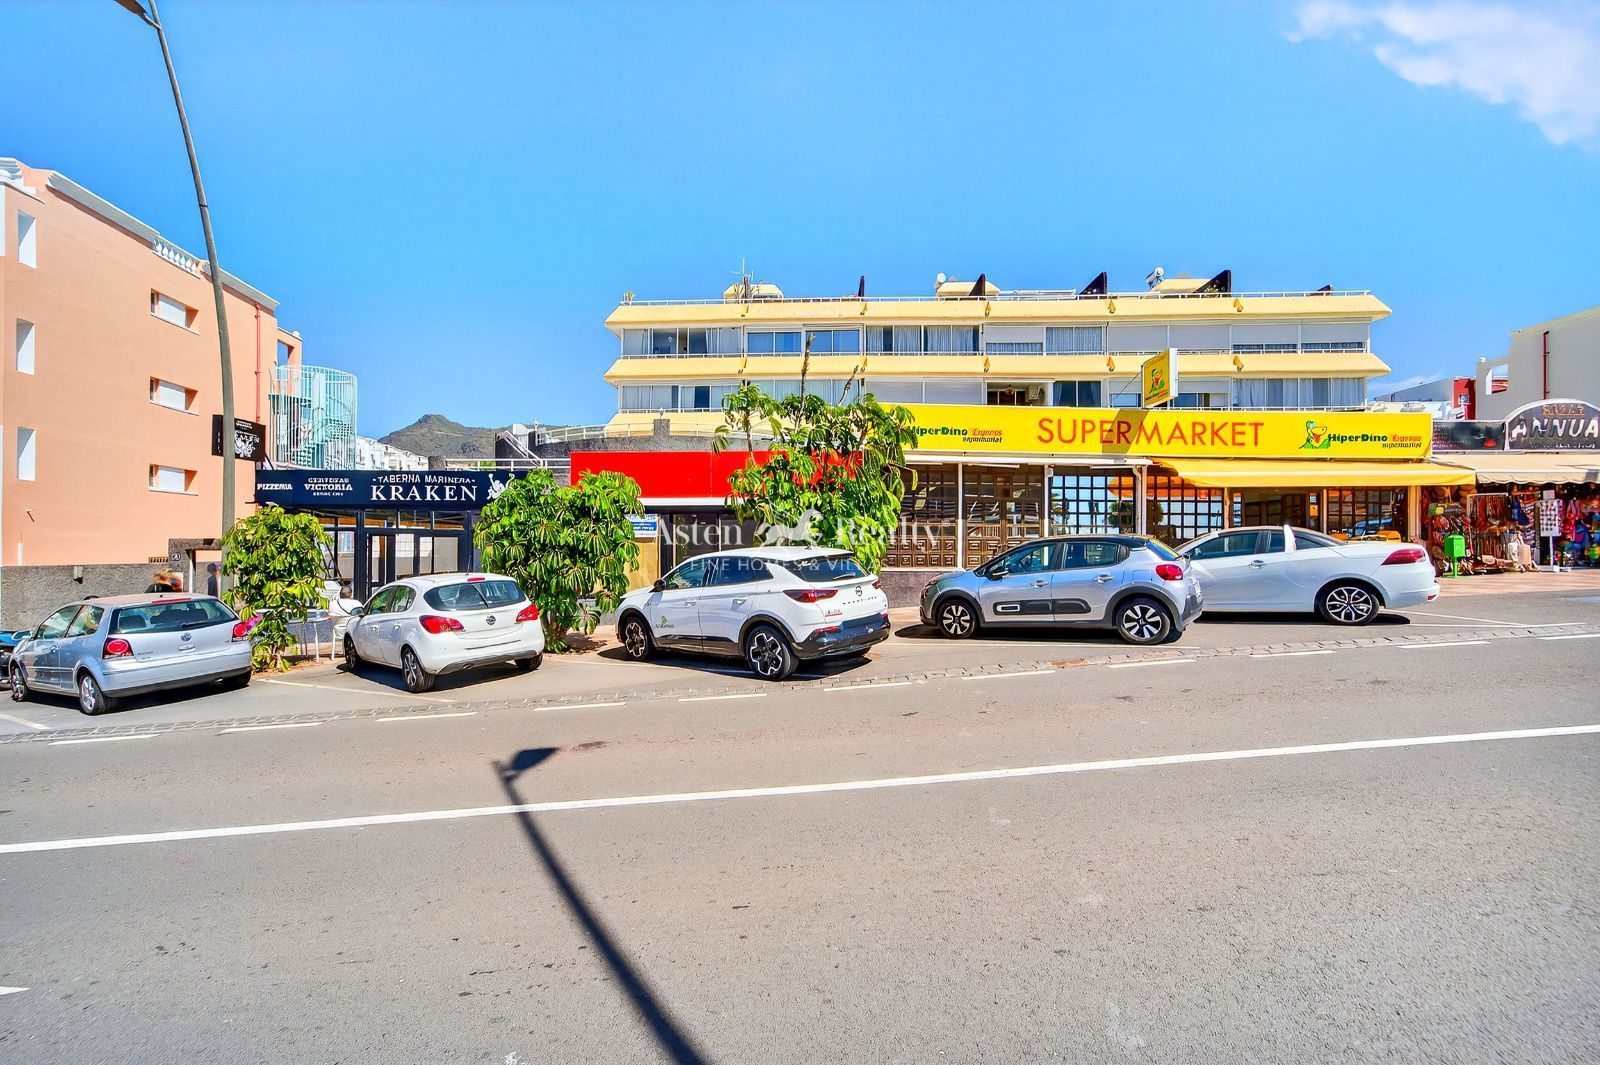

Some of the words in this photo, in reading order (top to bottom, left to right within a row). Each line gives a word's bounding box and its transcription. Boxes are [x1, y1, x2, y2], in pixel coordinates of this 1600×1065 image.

[1327, 433, 1388, 443] HiperDino
[256, 483, 293, 491] PIZZERIA
[303, 483, 353, 492] VICTORIA
[370, 484, 478, 502] KRAKEN
